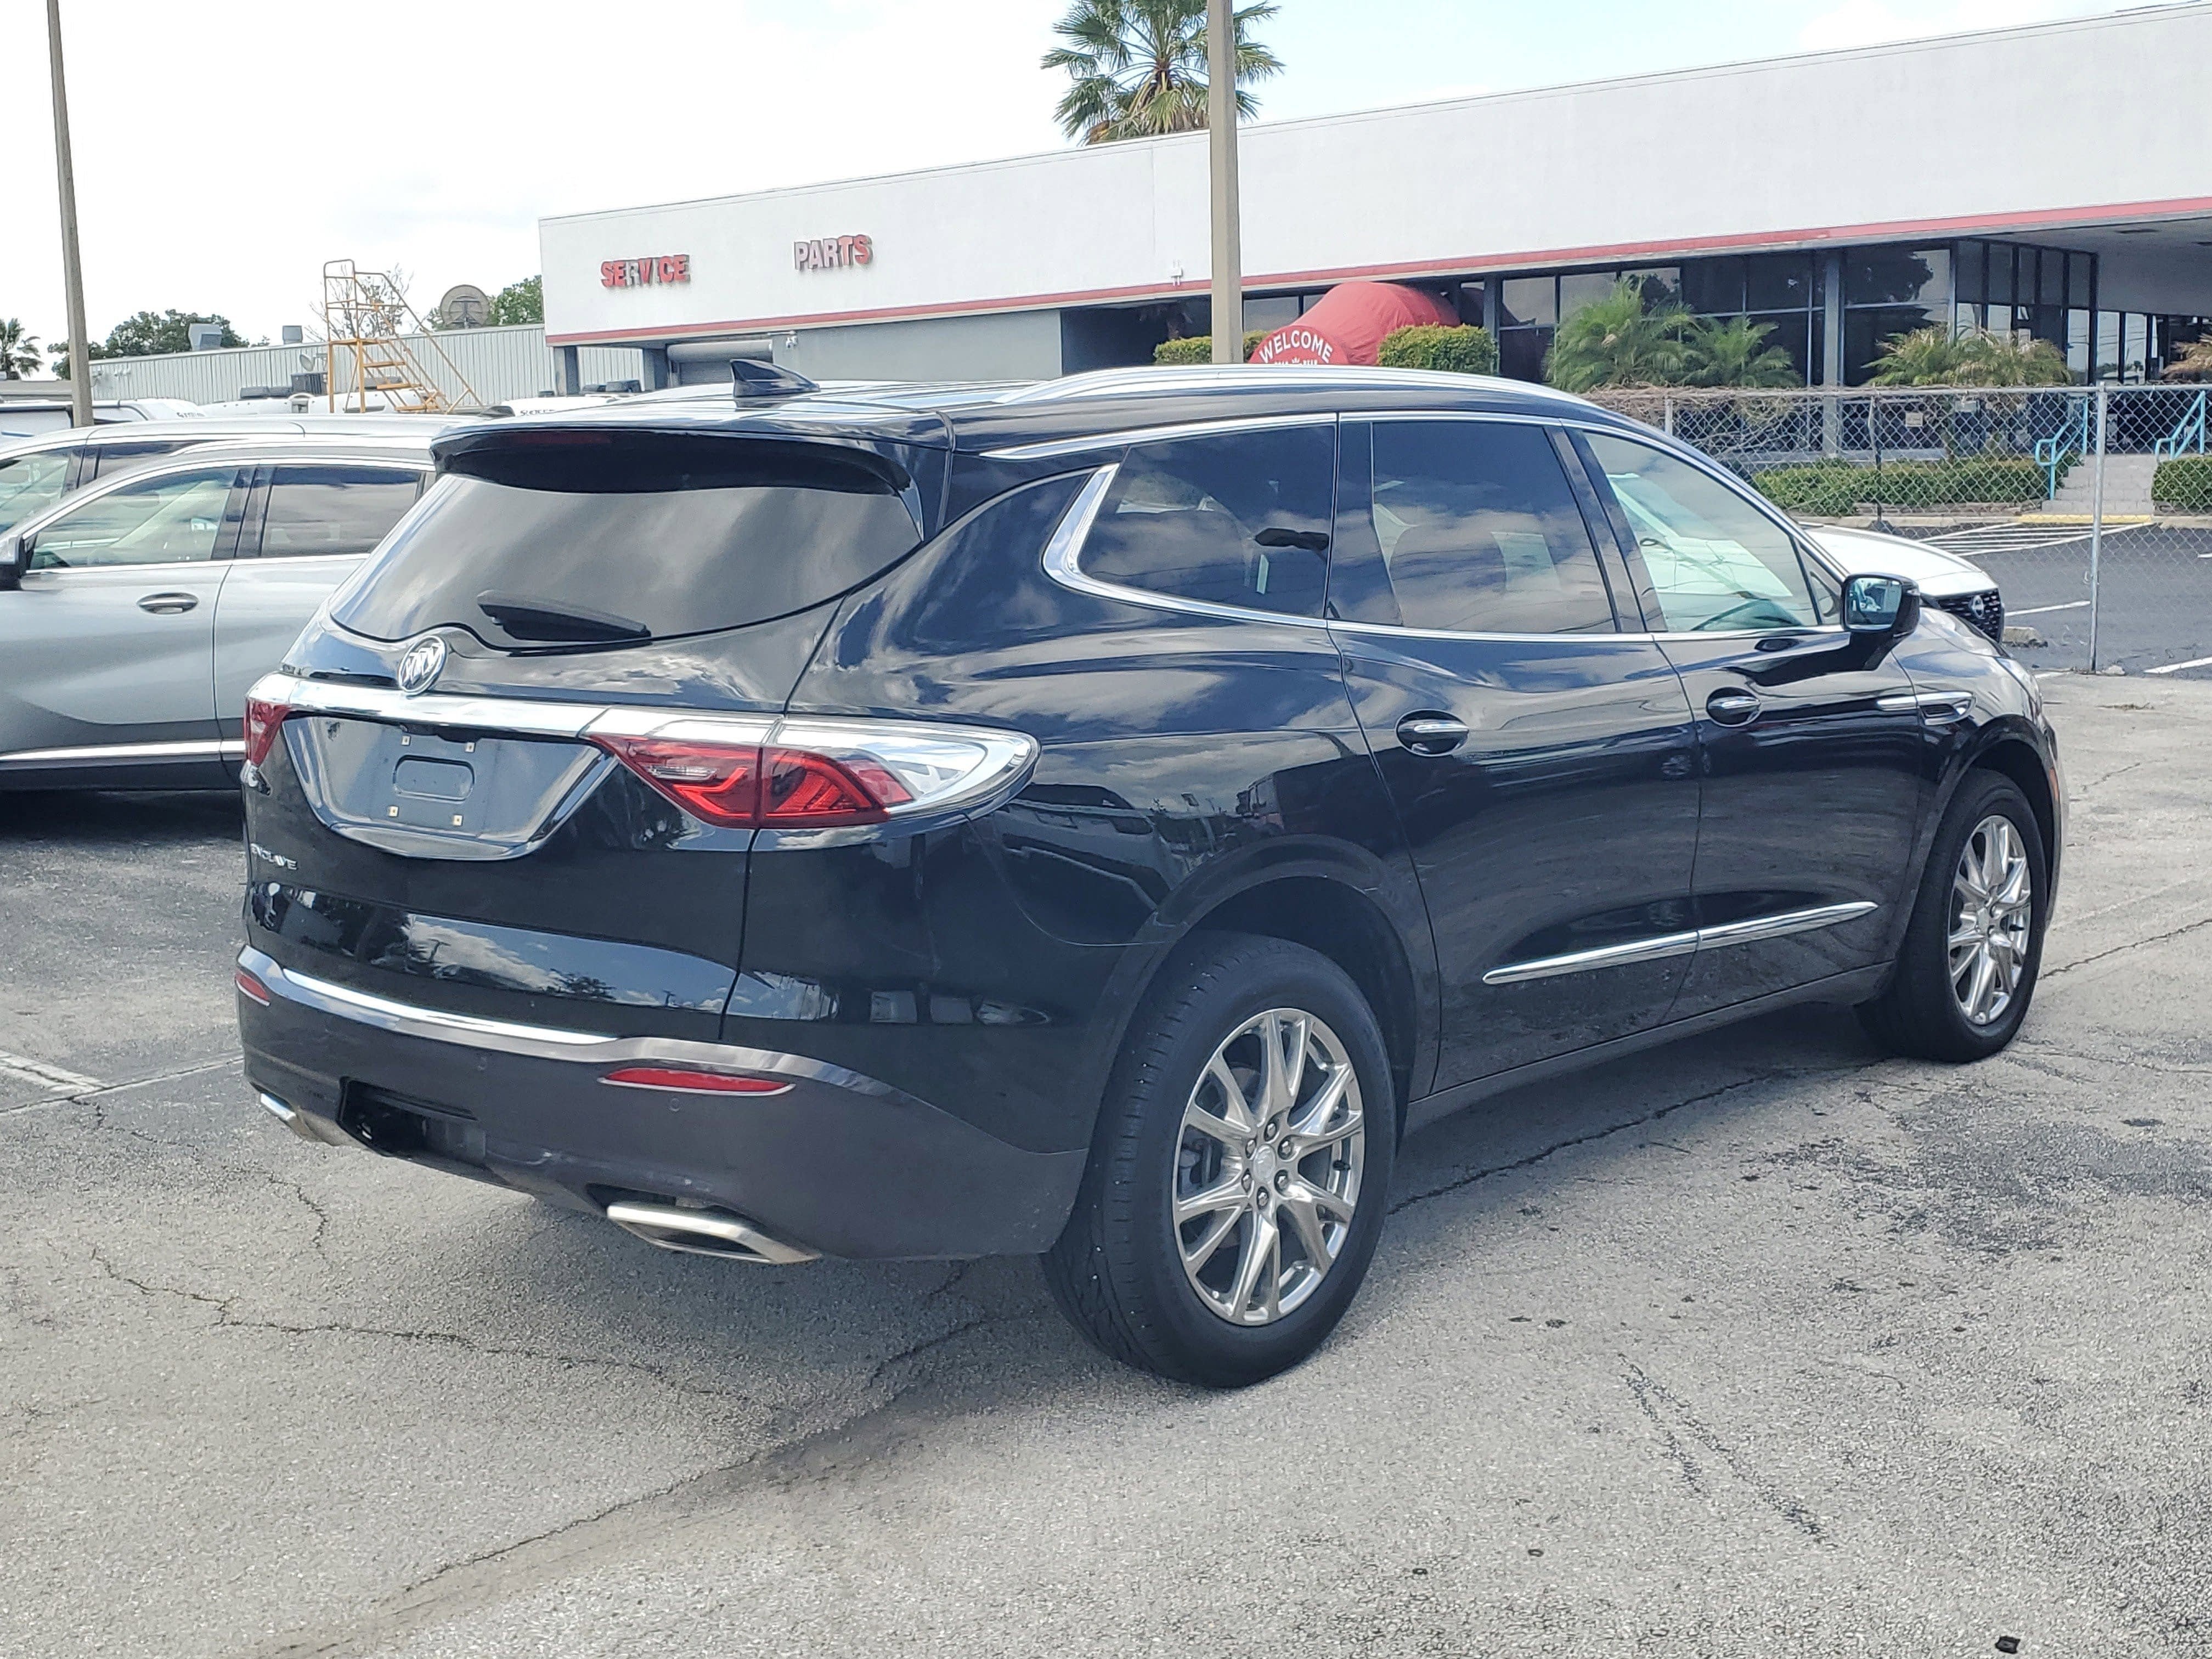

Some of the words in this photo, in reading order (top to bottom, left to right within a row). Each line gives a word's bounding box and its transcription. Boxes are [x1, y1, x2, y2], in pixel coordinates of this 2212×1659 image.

[794, 234, 873, 270] PARTS
[601, 254, 690, 287] SERVICE
[1259, 330, 1333, 364] WELCOME
